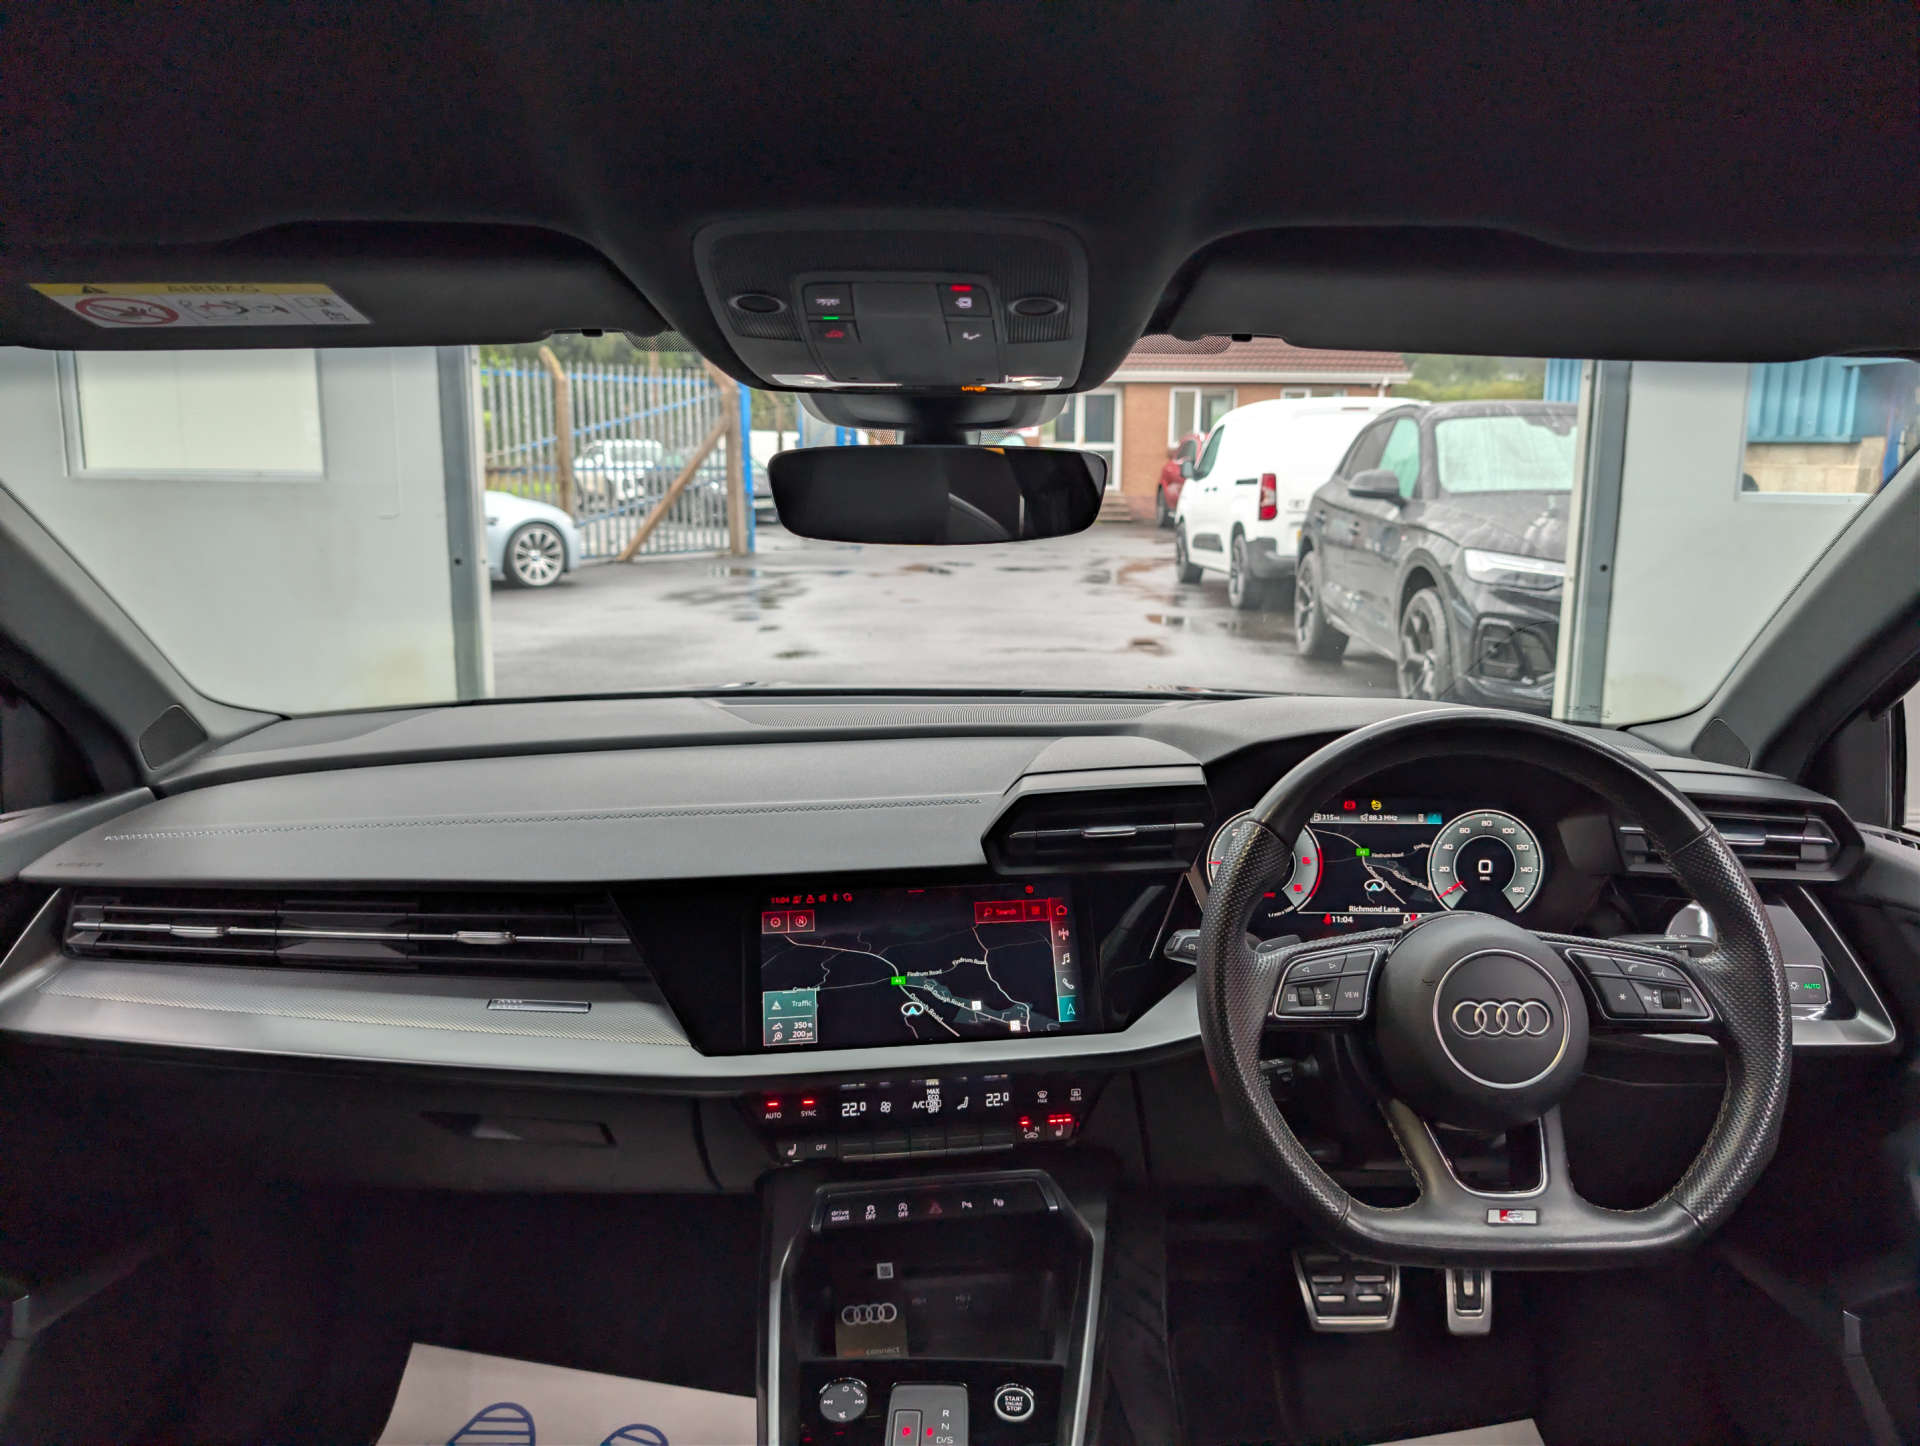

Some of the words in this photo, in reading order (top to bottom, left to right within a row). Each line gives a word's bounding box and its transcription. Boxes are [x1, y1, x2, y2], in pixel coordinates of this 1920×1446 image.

[1348, 905, 1382, 913] Richmond
[1384, 905, 1400, 913] Lane
[1332, 915, 1353, 923] 11:04
[792, 1000, 812, 1008] Traffic
[794, 1021, 808, 1029] 350
[912, 1101, 925, 1110] A/C
[765, 1111, 782, 1119] AUTO
[801, 1109, 817, 1117] SYNC
[815, 1143, 828, 1151] OFF
[942, 1409, 950, 1417] R
[936, 1436, 954, 1445] D/S
